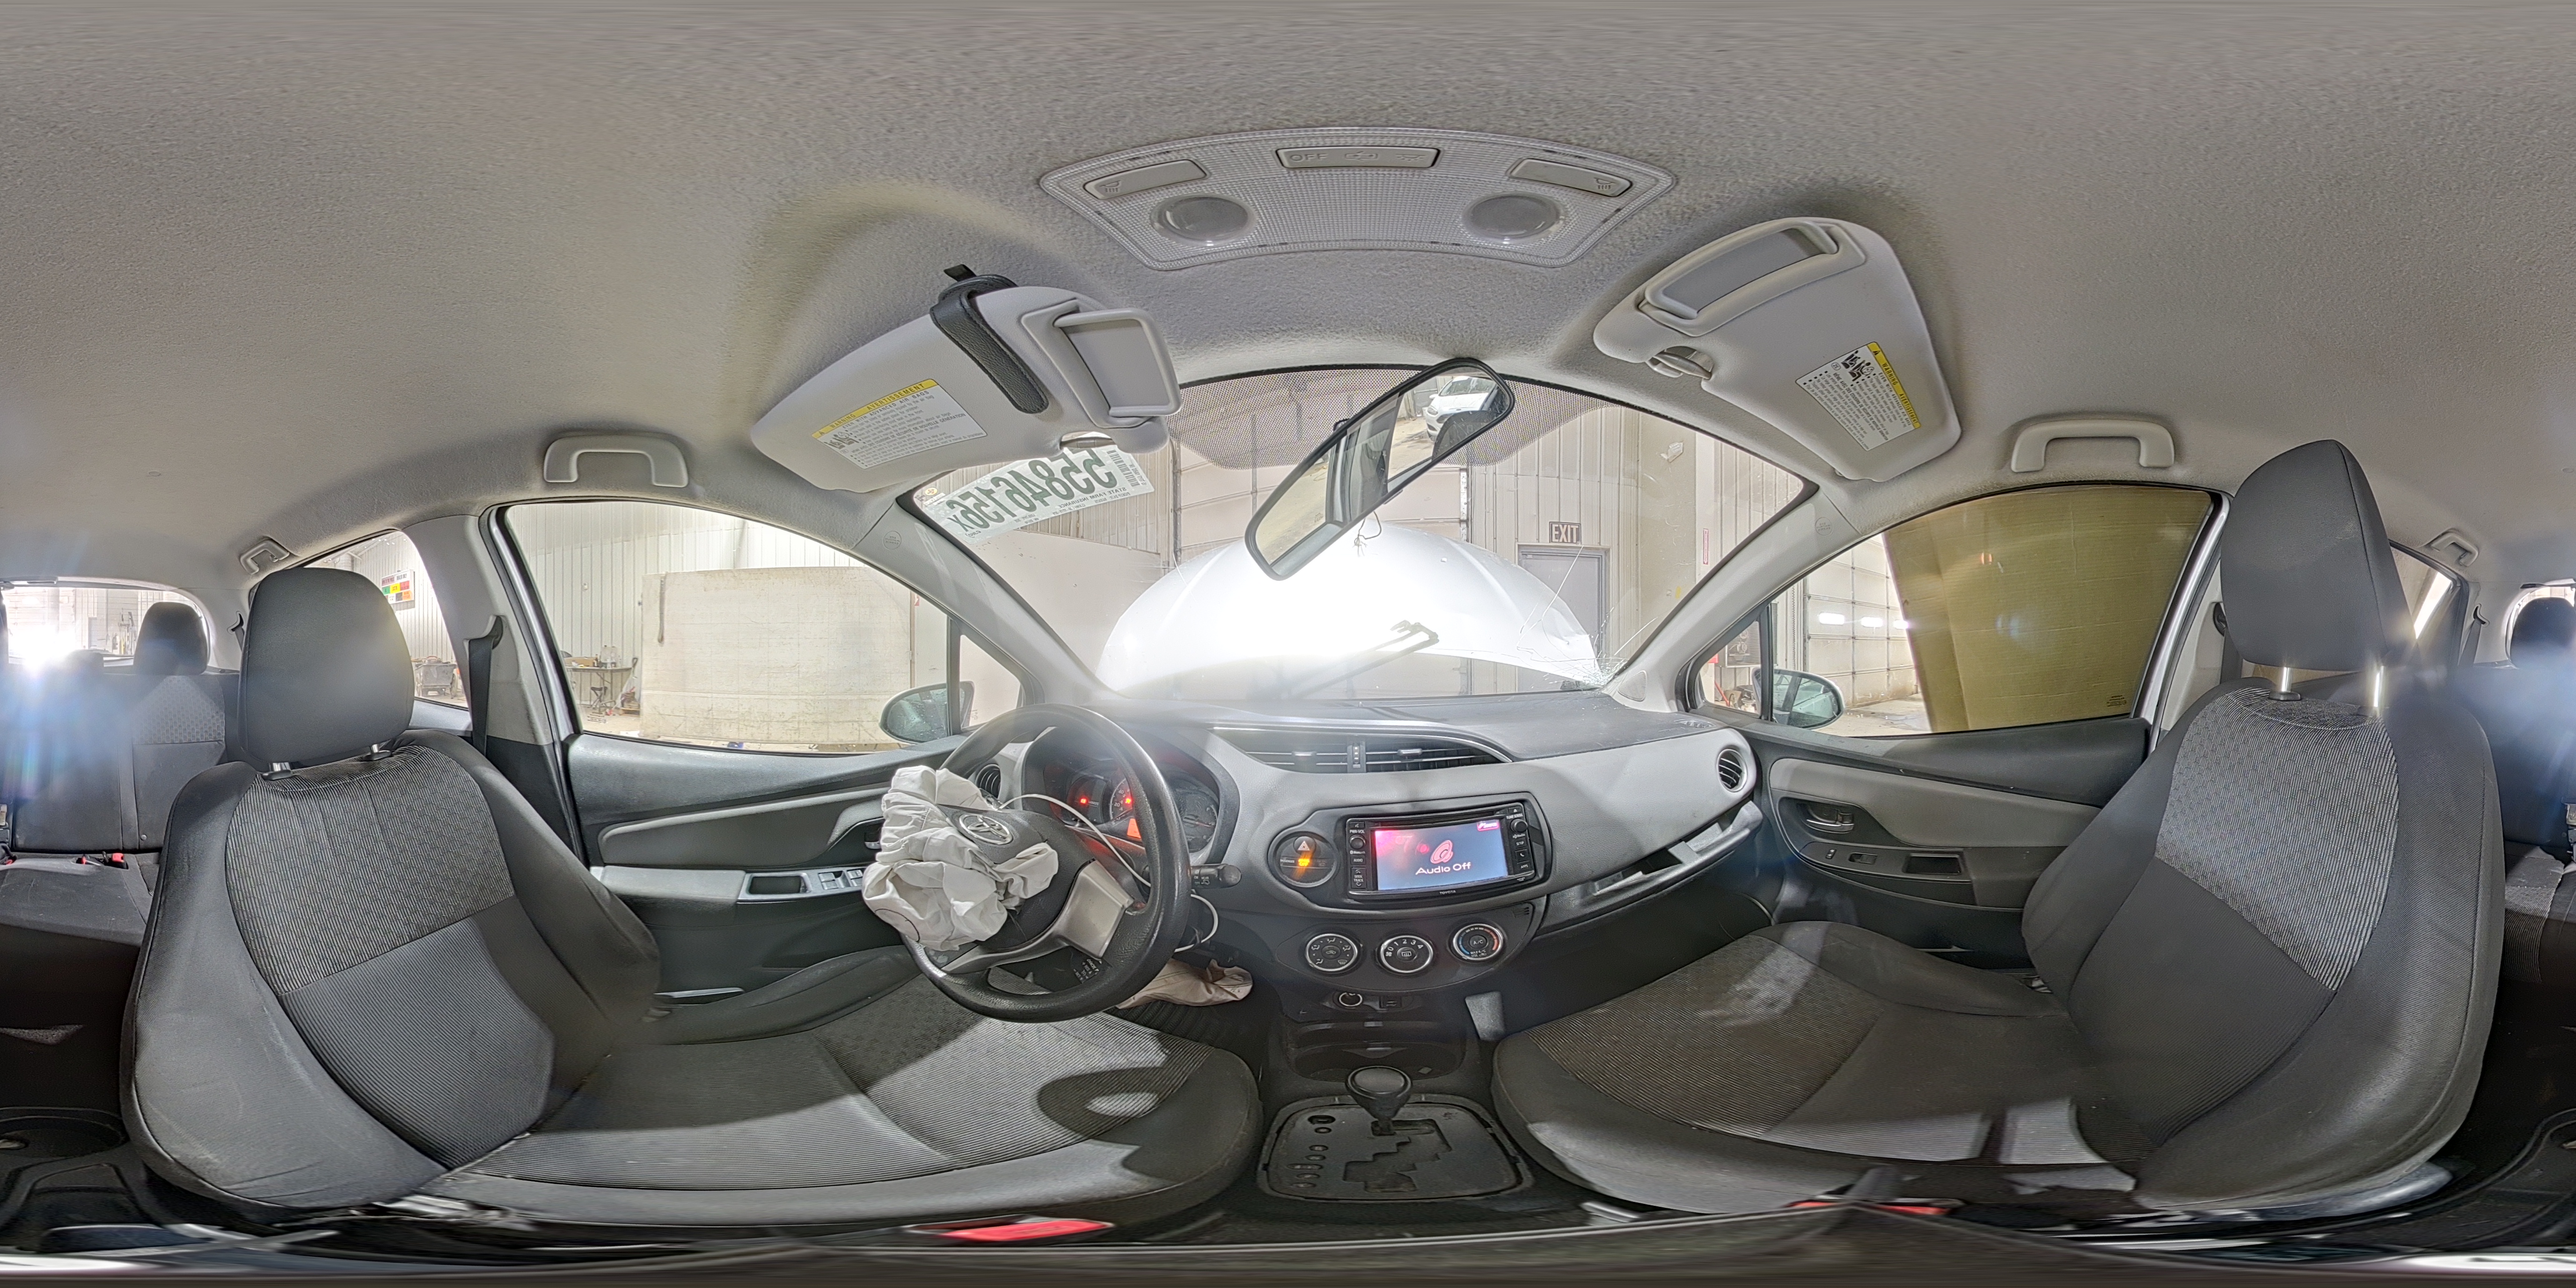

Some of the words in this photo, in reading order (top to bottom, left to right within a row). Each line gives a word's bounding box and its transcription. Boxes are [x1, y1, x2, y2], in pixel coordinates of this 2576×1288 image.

[1290, 153, 1328, 161] OFF
[1878, 372, 1887, 382] EVEN
[1885, 383, 1893, 393] WITH
[1881, 362, 1898, 386] WARNING
[1898, 393, 1918, 424] AVERTISSEMENT
[828, 413, 857, 428] WARNING
[866, 381, 926, 411] AVERTISSEMENT
[869, 402, 897, 416] ADVANCED
[911, 389, 929, 399] BAGS
[1552, 524, 1579, 543] EXIT
[1415, 865, 1450, 875] Audio
[1453, 862, 1471, 871] Off
